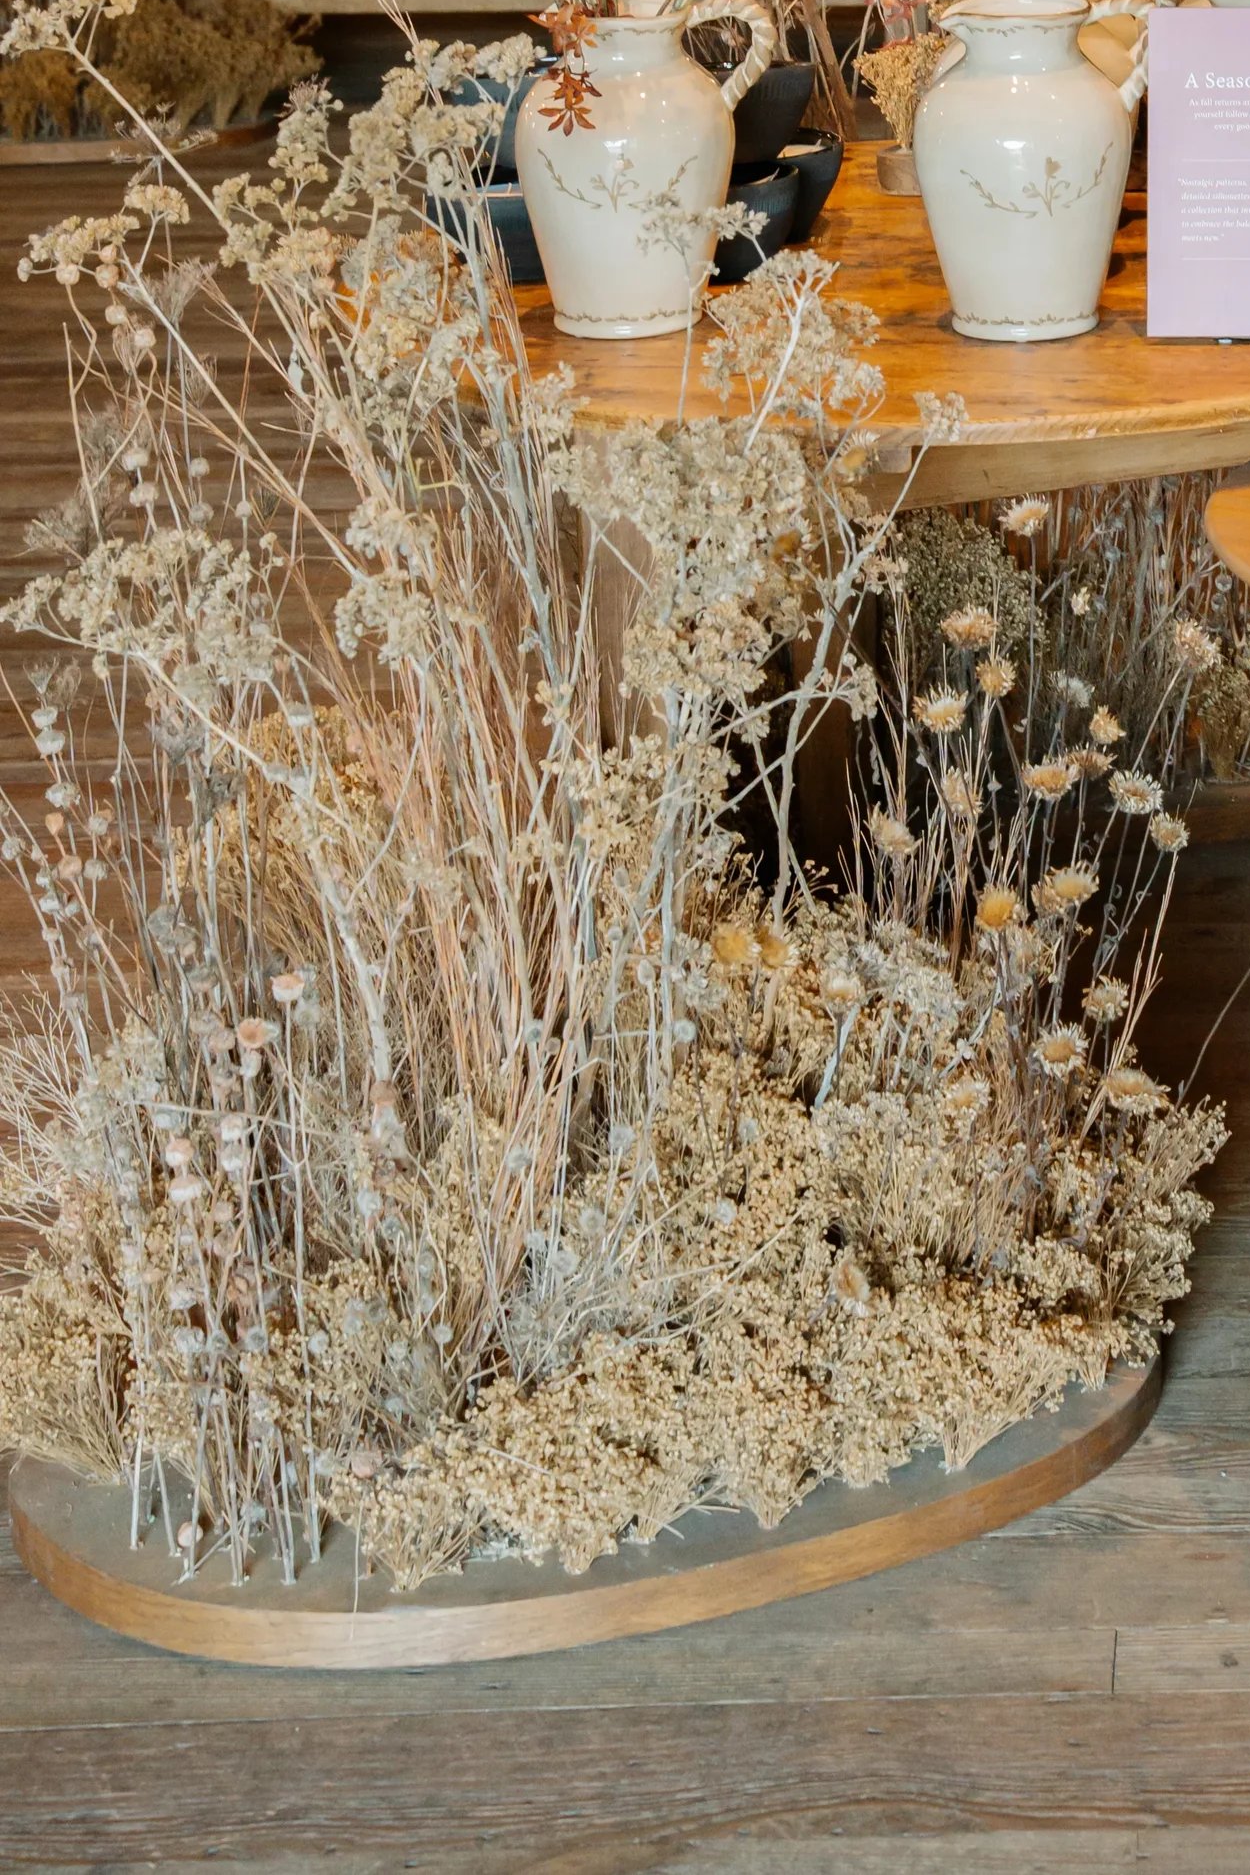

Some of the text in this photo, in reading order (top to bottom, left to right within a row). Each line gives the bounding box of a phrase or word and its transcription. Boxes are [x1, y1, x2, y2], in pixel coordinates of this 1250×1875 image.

[1184, 72, 1200, 89] A
[1189, 98, 1199, 106] As
[1200, 97, 1213, 106] fall
[1214, 98, 1241, 106] returns
[1194, 110, 1223, 120] yourself
[1225, 109, 1249, 118] follow
[1214, 123, 1235, 132] every
[1181, 192, 1211, 200] detailed
[1188, 205, 1223, 214] collection
[1224, 206, 1240, 214] that
[1191, 220, 1221, 228] embrace
[1222, 220, 1235, 228] the
[1181, 234, 1203, 242] meets
